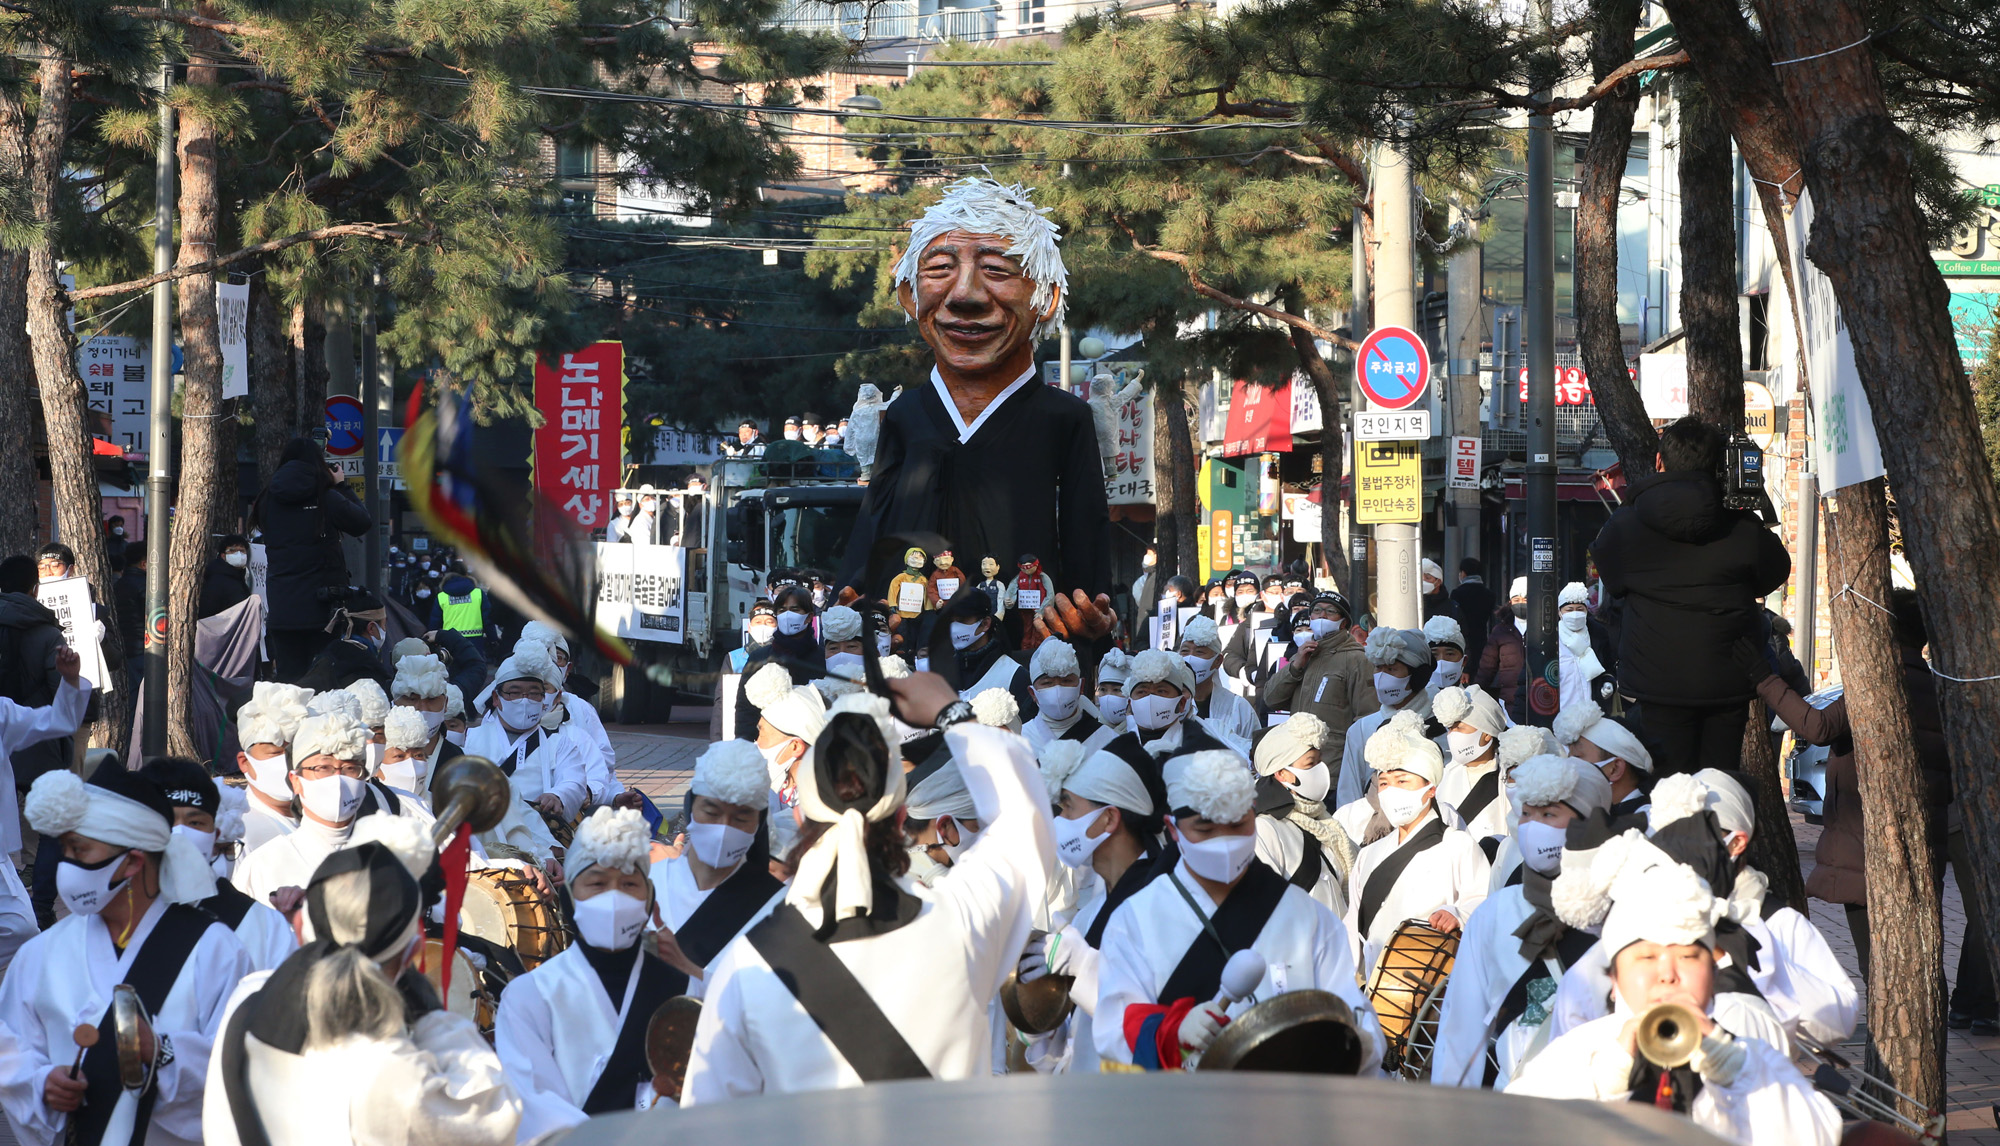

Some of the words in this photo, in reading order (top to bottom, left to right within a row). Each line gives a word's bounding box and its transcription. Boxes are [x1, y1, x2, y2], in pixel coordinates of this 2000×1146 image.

[1943, 262, 1972, 273] Coffee
[88, 347, 140, 359] 정이가네
[1370, 361, 1416, 374] 주차금지
[1362, 416, 1422, 434] 견인지역
[1457, 440, 1476, 476] 모텔
[1361, 475, 1416, 491] 불법주정차
[1362, 498, 1416, 512] 무인단속중
